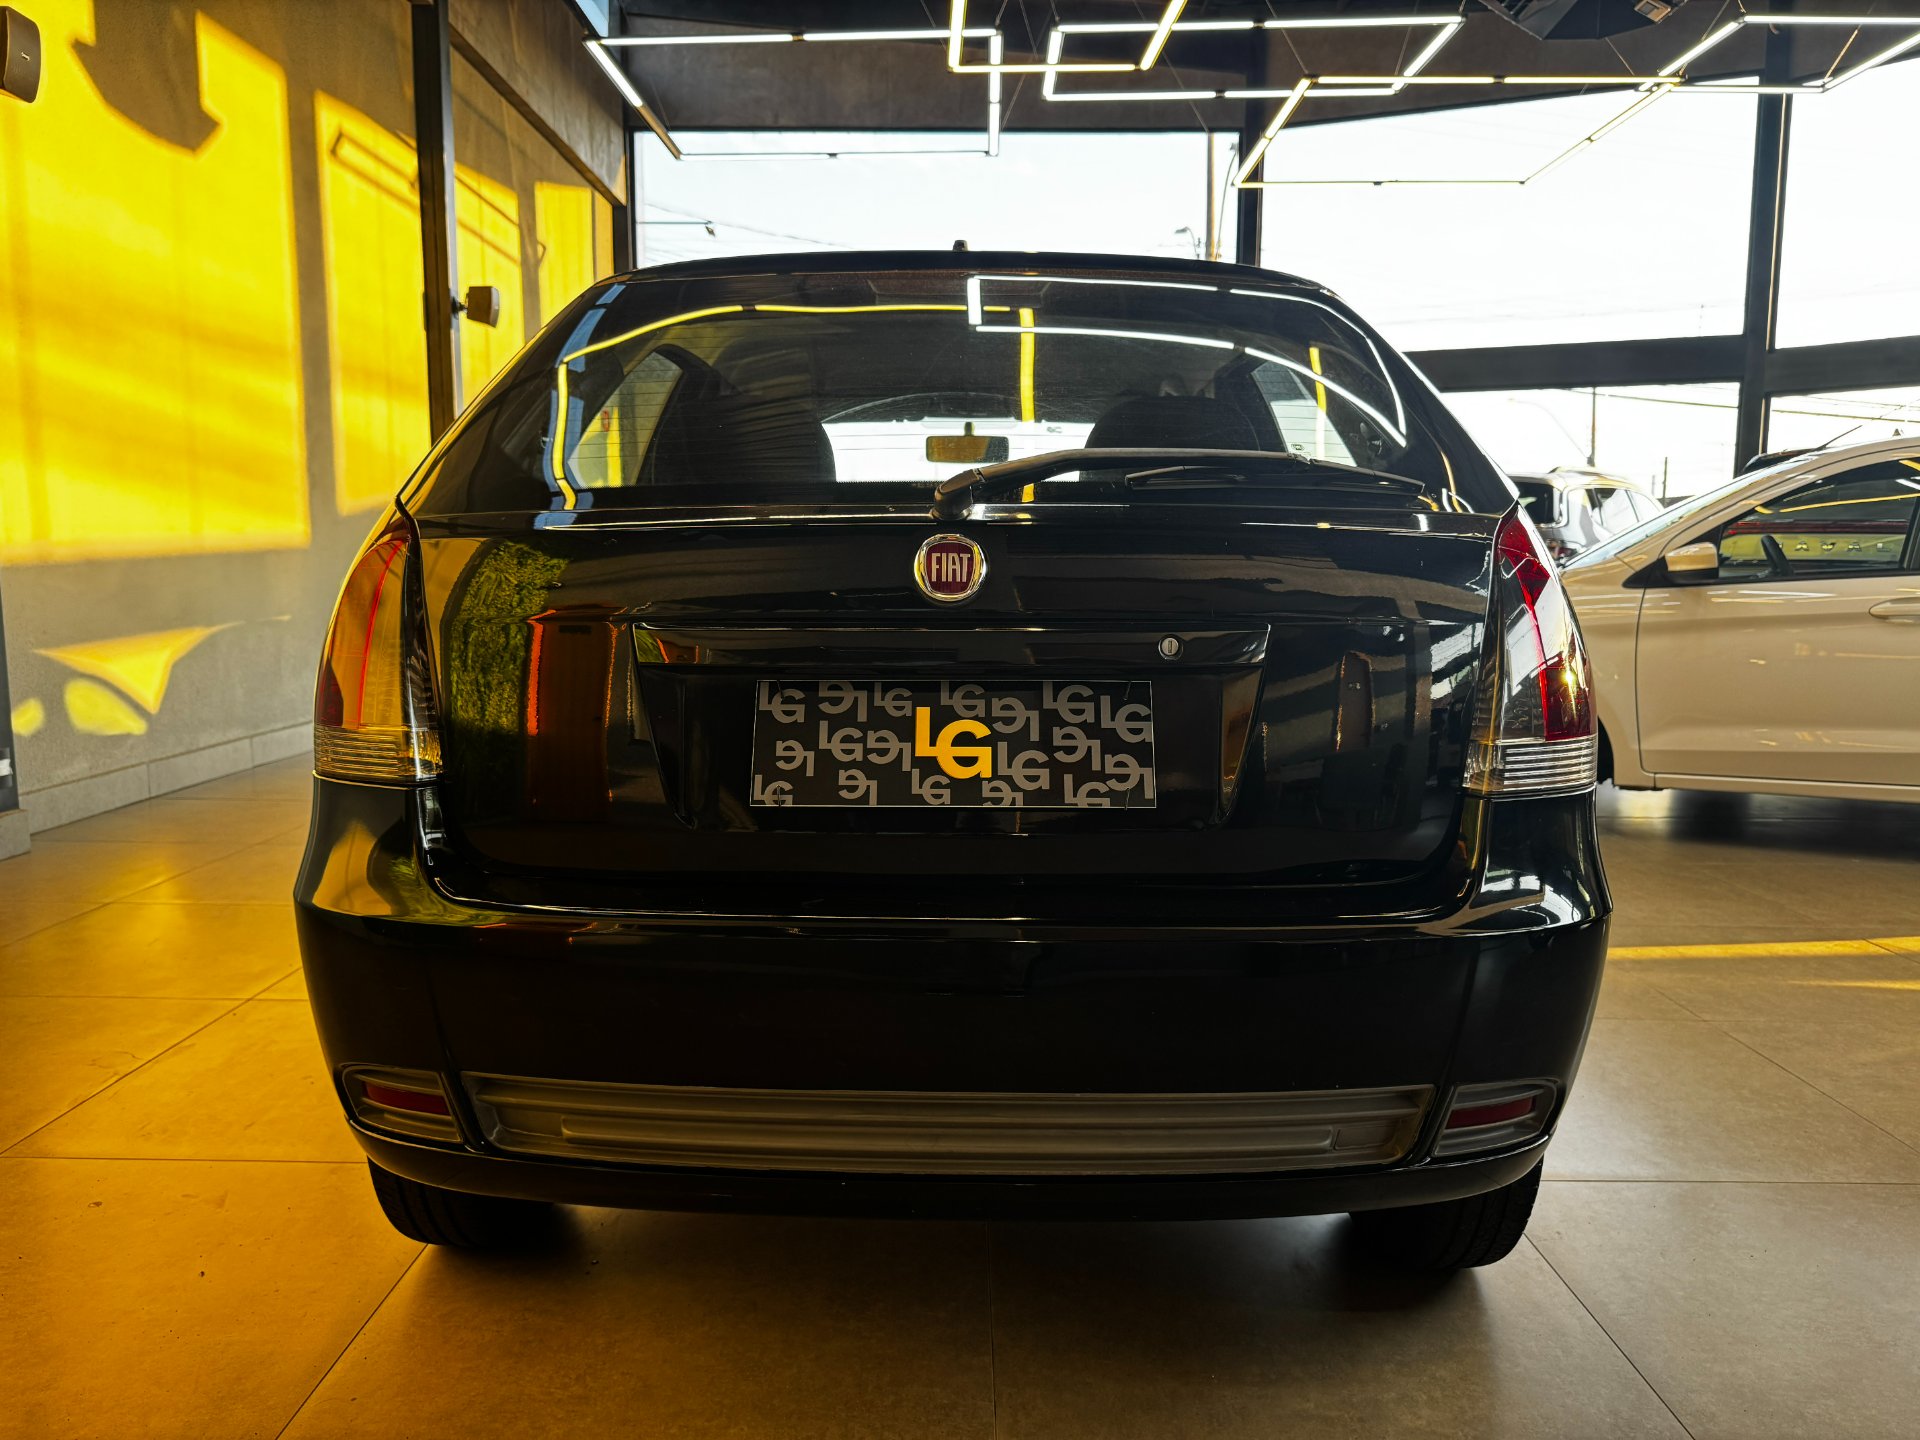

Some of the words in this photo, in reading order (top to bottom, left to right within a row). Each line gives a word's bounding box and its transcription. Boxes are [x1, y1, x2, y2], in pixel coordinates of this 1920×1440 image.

[931, 552, 971, 583] FIAT
[1777, 540, 1891, 553] AVAL
[759, 681, 806, 724] LG
[874, 682, 913, 717] LG
[940, 681, 986, 718] LG
[1042, 681, 1095, 724] LG
[1100, 695, 1153, 743] LG
[818, 720, 865, 762] LG
[914, 706, 992, 780] LG
[911, 768, 951, 805] LG
[997, 741, 1050, 791] LG
